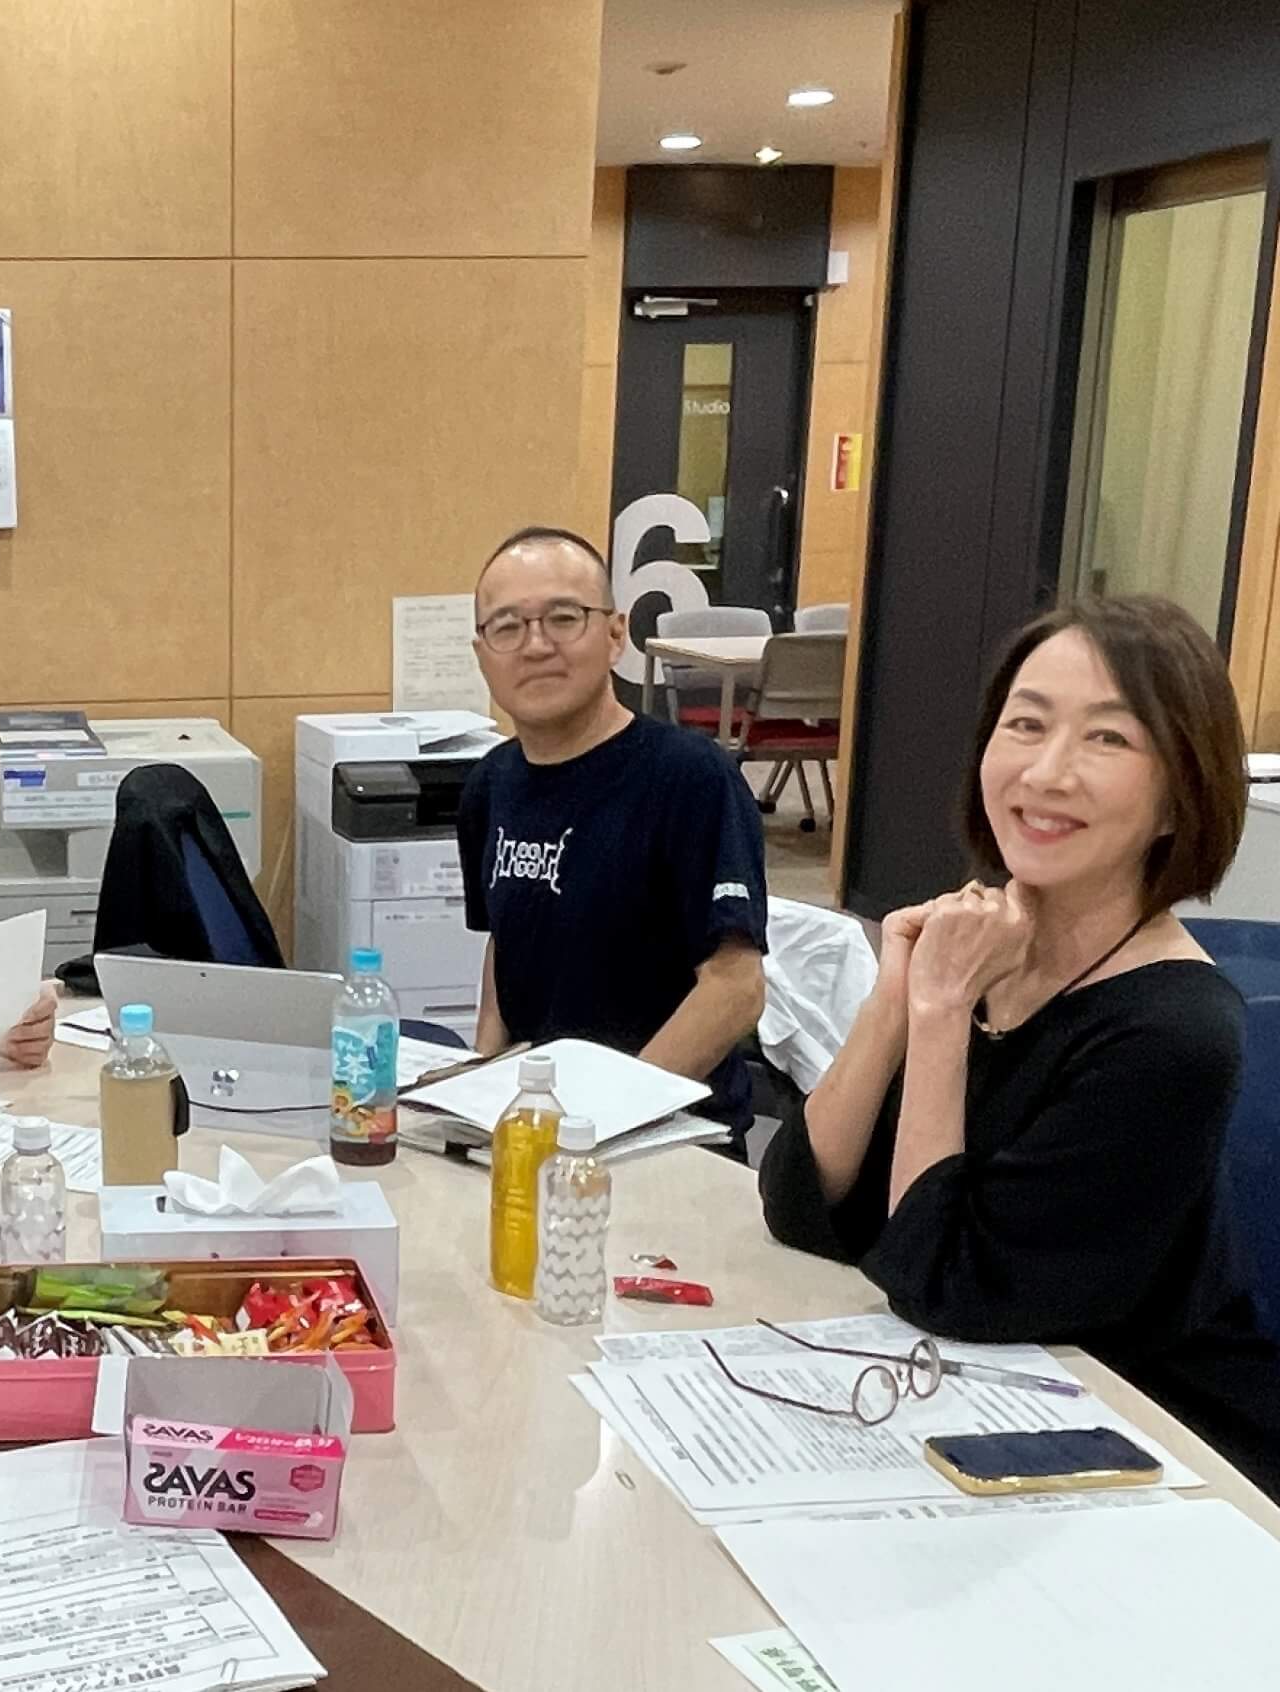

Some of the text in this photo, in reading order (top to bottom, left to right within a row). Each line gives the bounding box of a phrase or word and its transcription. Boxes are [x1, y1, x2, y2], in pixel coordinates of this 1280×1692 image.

[612, 493, 711, 685] 6
[142, 1423, 214, 1441] SAVAS
[143, 1462, 256, 1502] SAVAS
[147, 1494, 248, 1514] PROTEIN BAR
